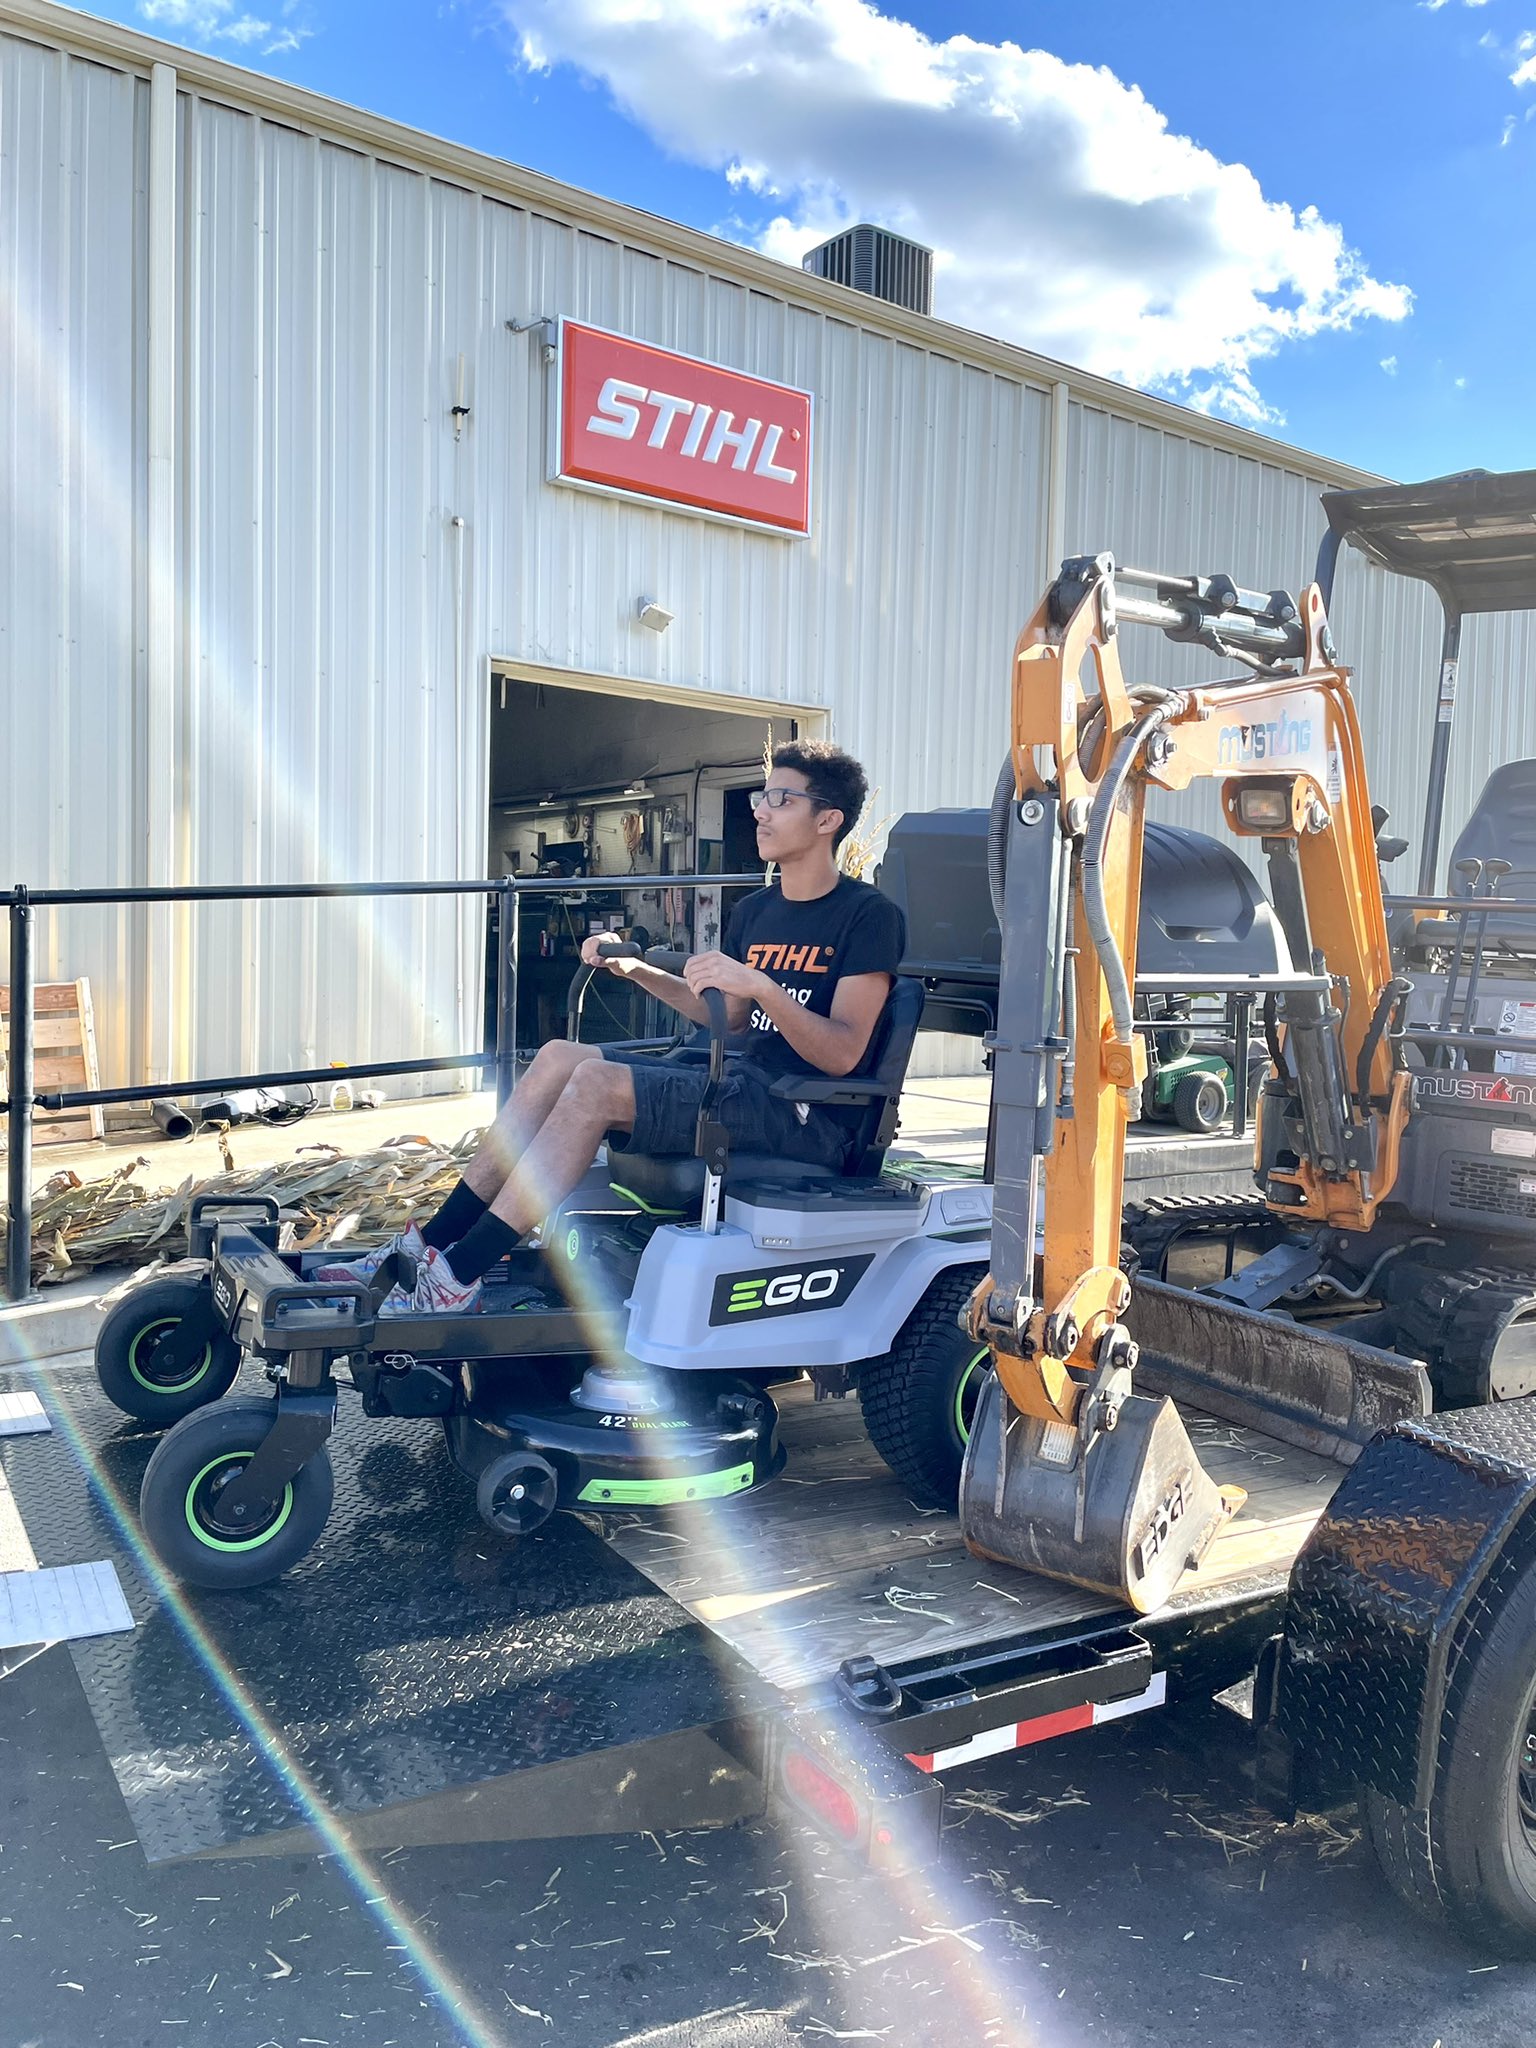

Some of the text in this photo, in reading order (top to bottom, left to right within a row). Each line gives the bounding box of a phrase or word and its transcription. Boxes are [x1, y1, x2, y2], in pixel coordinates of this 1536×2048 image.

[586, 378, 797, 484] STIHL
[745, 944, 829, 973] STIHL
[216, 1280, 230, 1308] EGO
[727, 1269, 839, 1313] EGO
